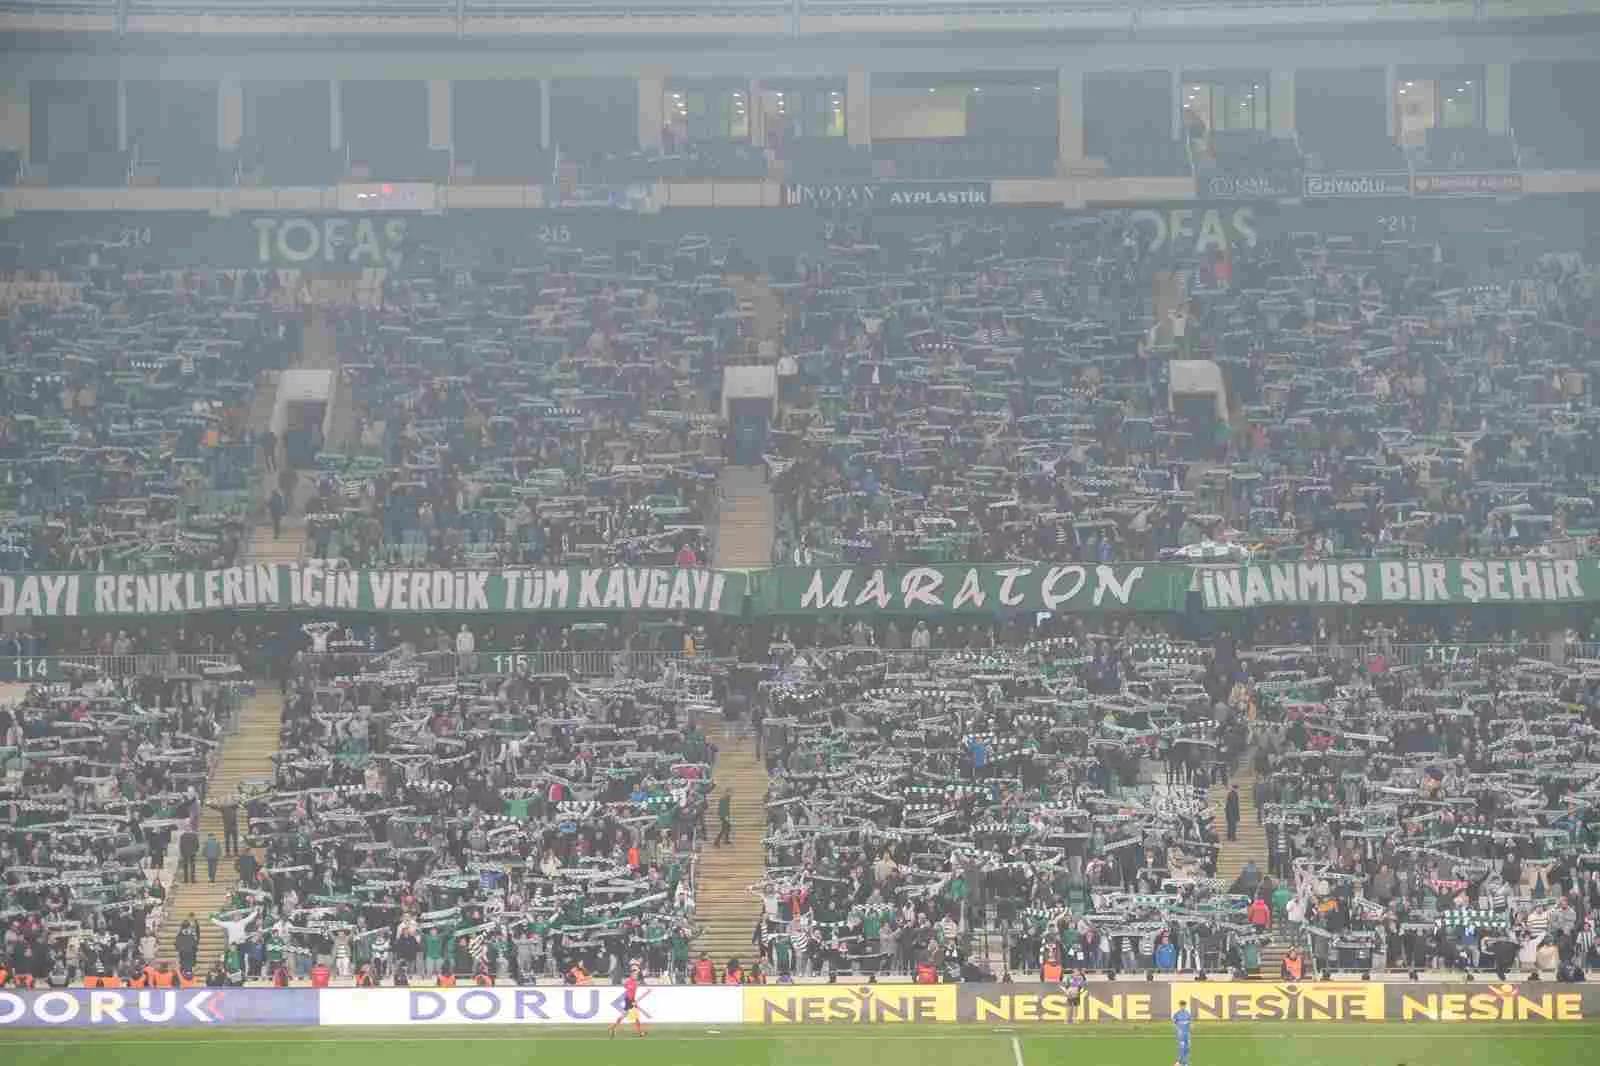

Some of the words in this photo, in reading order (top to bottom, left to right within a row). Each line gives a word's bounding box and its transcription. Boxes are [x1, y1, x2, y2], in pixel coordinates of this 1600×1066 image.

[369, 570, 489, 611] VERDİK
[502, 569, 569, 610] TÜM
[578, 568, 727, 611] KAVGAYI
[799, 565, 1145, 611] MARATON
[1380, 561, 1450, 602] BİR
[1461, 560, 1585, 603] ŞEHİR
[13, 658, 48, 679] 114
